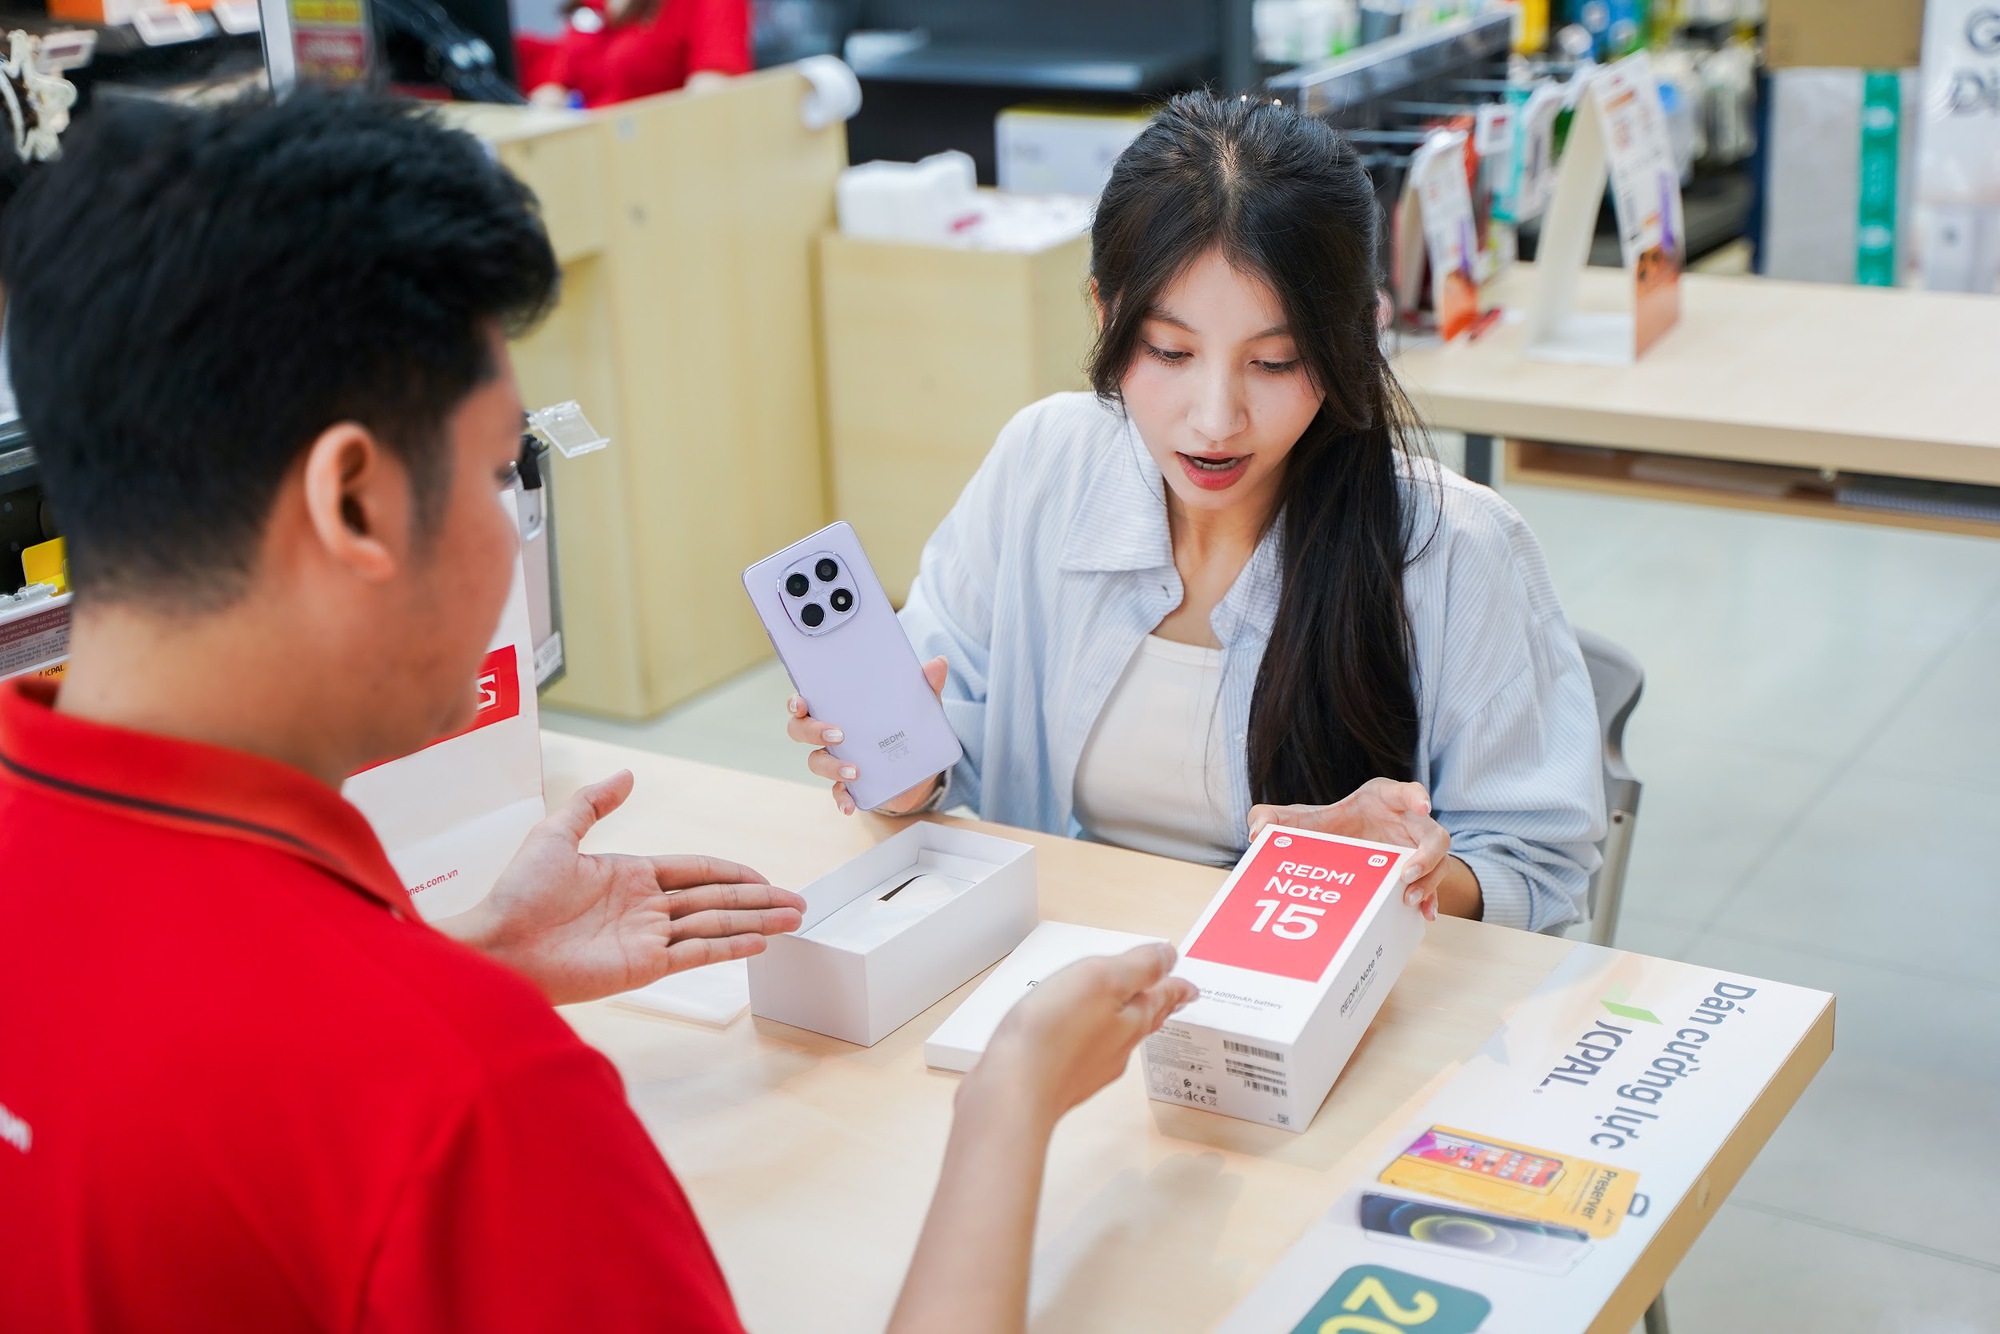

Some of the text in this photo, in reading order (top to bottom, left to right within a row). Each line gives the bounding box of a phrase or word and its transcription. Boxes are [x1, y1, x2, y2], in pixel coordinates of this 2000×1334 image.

[879, 730, 905, 749] REDMI
[1264, 876, 1342, 904] Note
[1277, 861, 1356, 886] REDMI
[1250, 900, 1327, 941] 15
[1340, 981, 1361, 1018] REDMI
[1360, 959, 1376, 985] Note
[1375, 944, 1383, 960] 15
[1214, 991, 1253, 1004] 6000mAh
[1253, 999, 1284, 1010] battery
[1589, 981, 1758, 1150] Dán cường lực
[1581, 1169, 1619, 1221] Preserver
